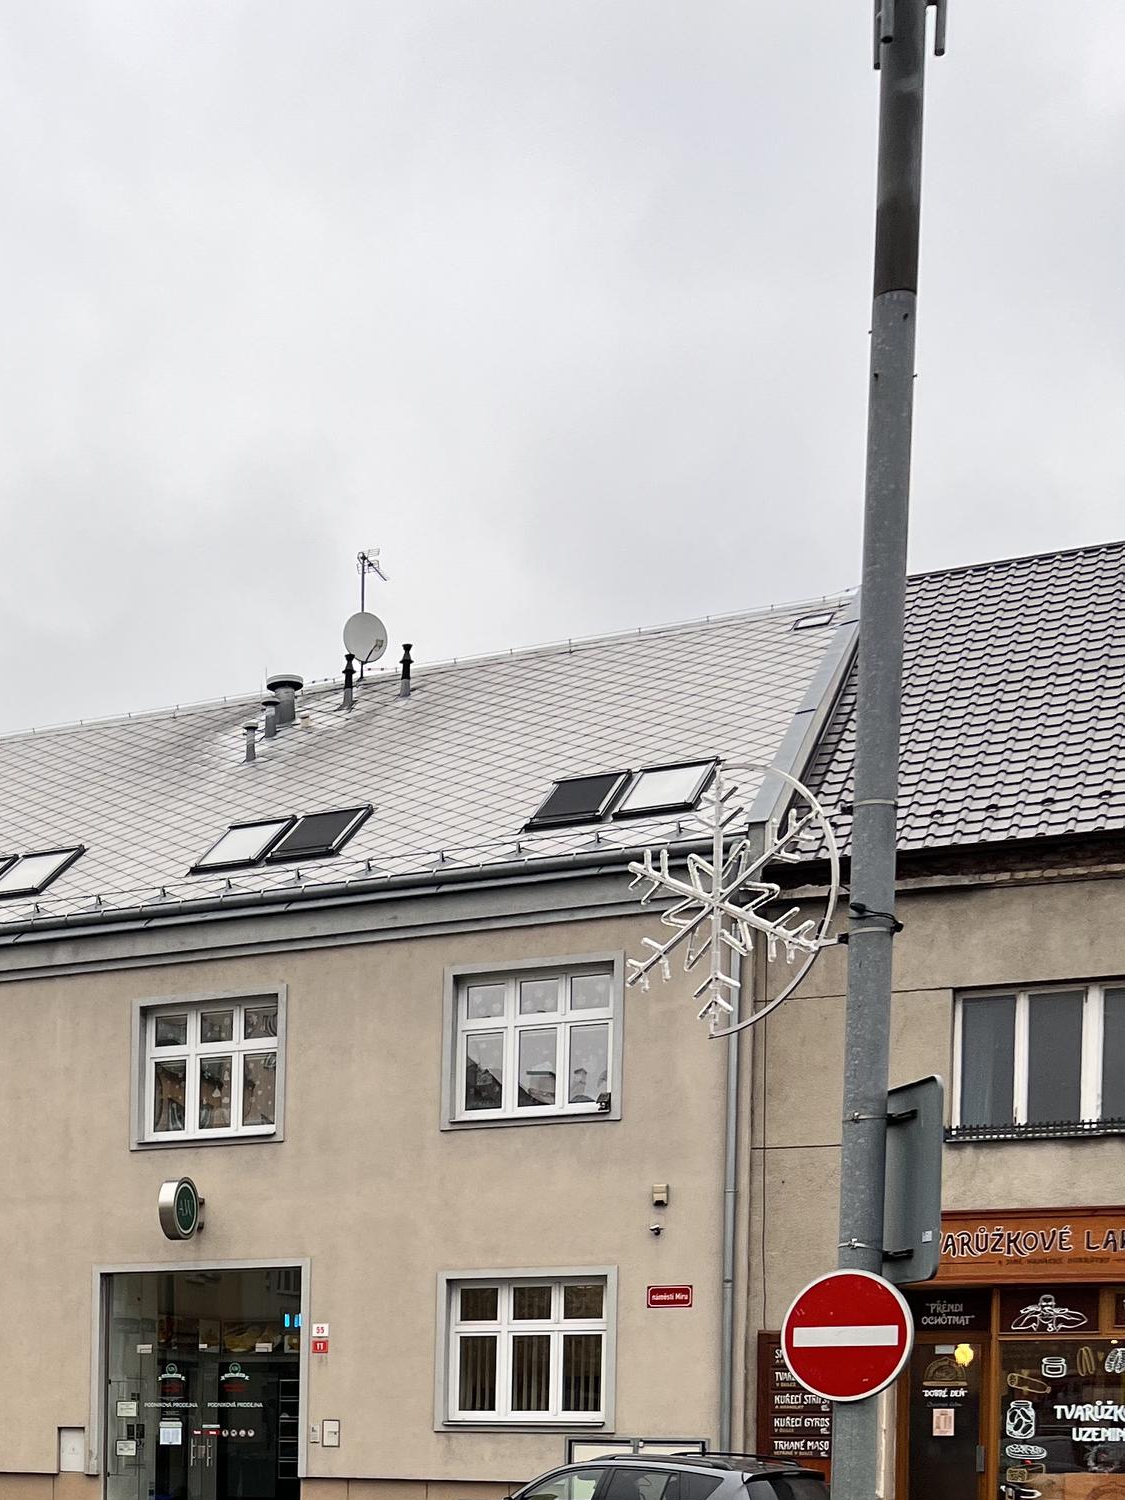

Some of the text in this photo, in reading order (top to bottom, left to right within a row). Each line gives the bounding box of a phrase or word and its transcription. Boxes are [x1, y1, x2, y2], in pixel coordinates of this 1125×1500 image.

[940, 1225, 1073, 1258] ARŮŽKOVÉ
[316, 1326, 325, 1334] 55
[774, 1393, 803, 1405] KUŘECÍ
[1053, 1400, 1125, 1422] TVARŮŽK
[774, 1416, 830, 1427] KUŘECÍ GYROS
[773, 1440, 830, 1451] TRHANÉ MASO
